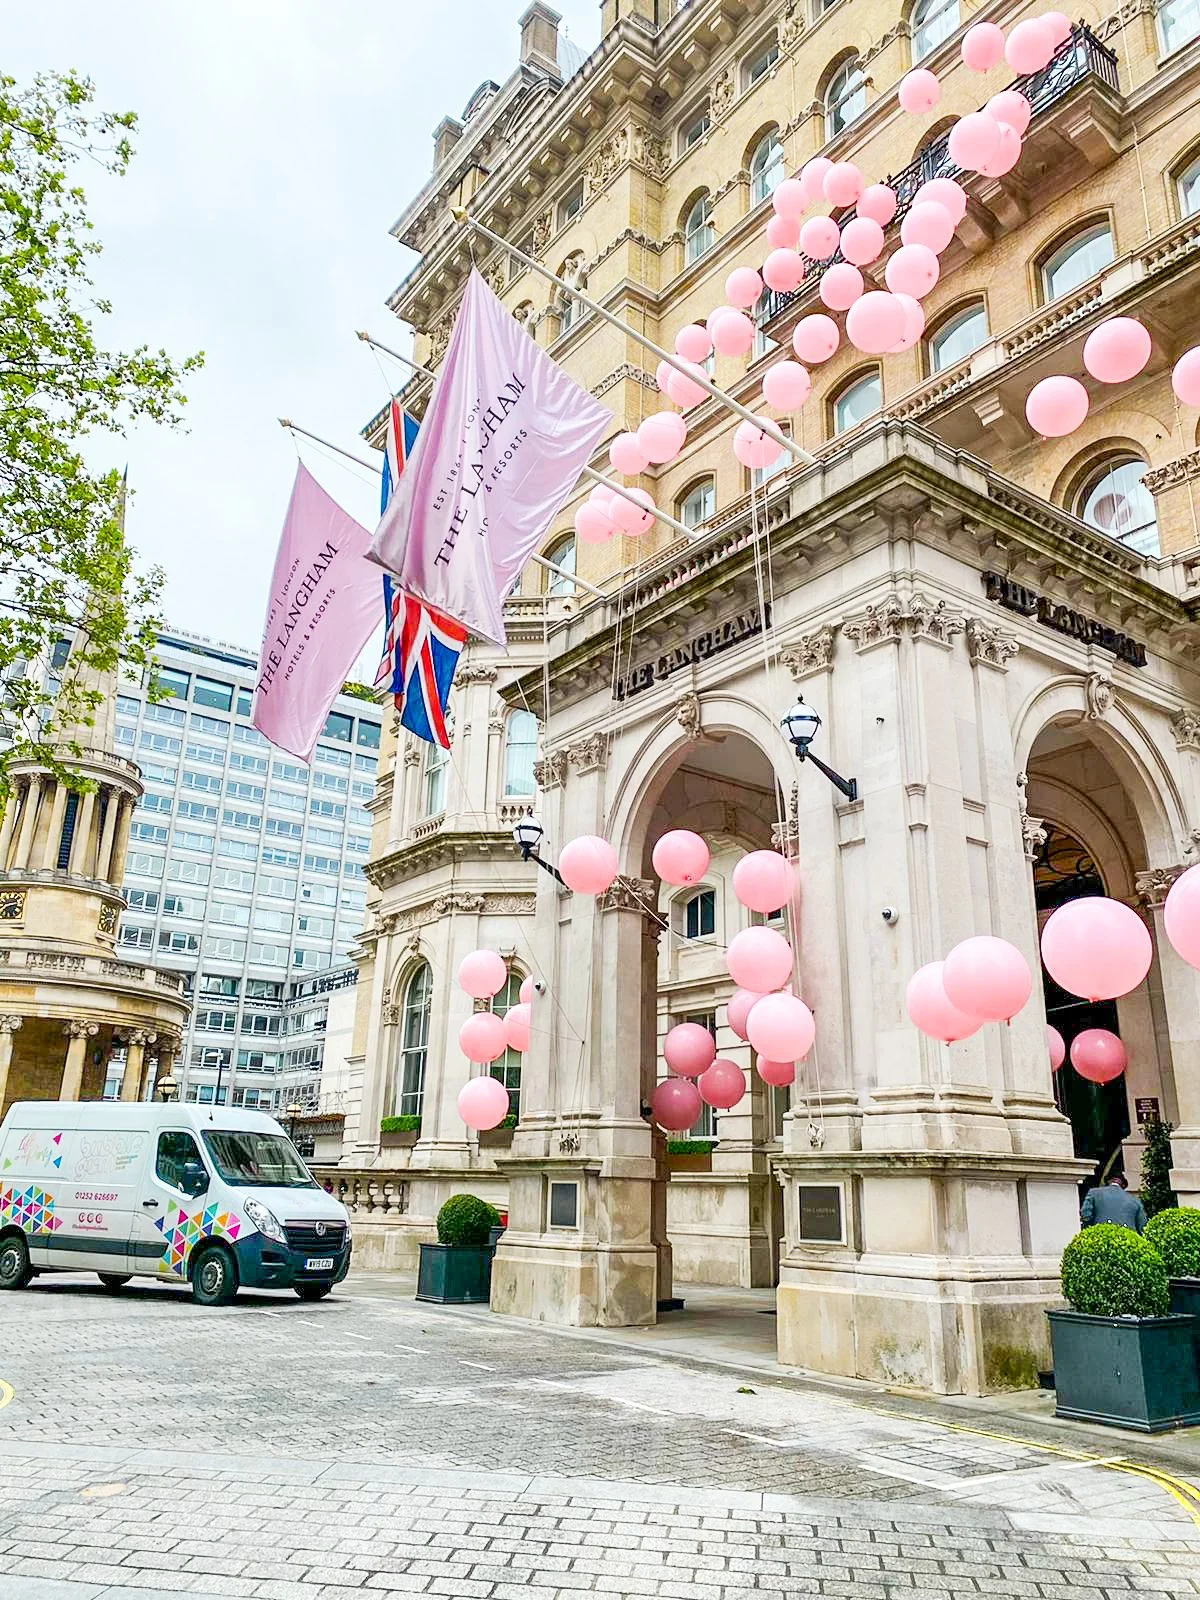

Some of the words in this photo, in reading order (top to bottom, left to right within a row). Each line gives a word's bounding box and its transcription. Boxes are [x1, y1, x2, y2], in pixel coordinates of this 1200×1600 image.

[433, 505, 468, 567] THE
[461, 372, 526, 498] LAGHAM
[490, 429, 528, 481] RESORTS
[433, 489, 448, 510] EST
[281, 558, 300, 596] LONDON
[255, 650, 282, 696] THE
[276, 541, 339, 649] LANGHAM
[284, 643, 305, 680] HOTELS
[308, 588, 336, 630] RESORTS
[654, 601, 774, 680] LANGHAM
